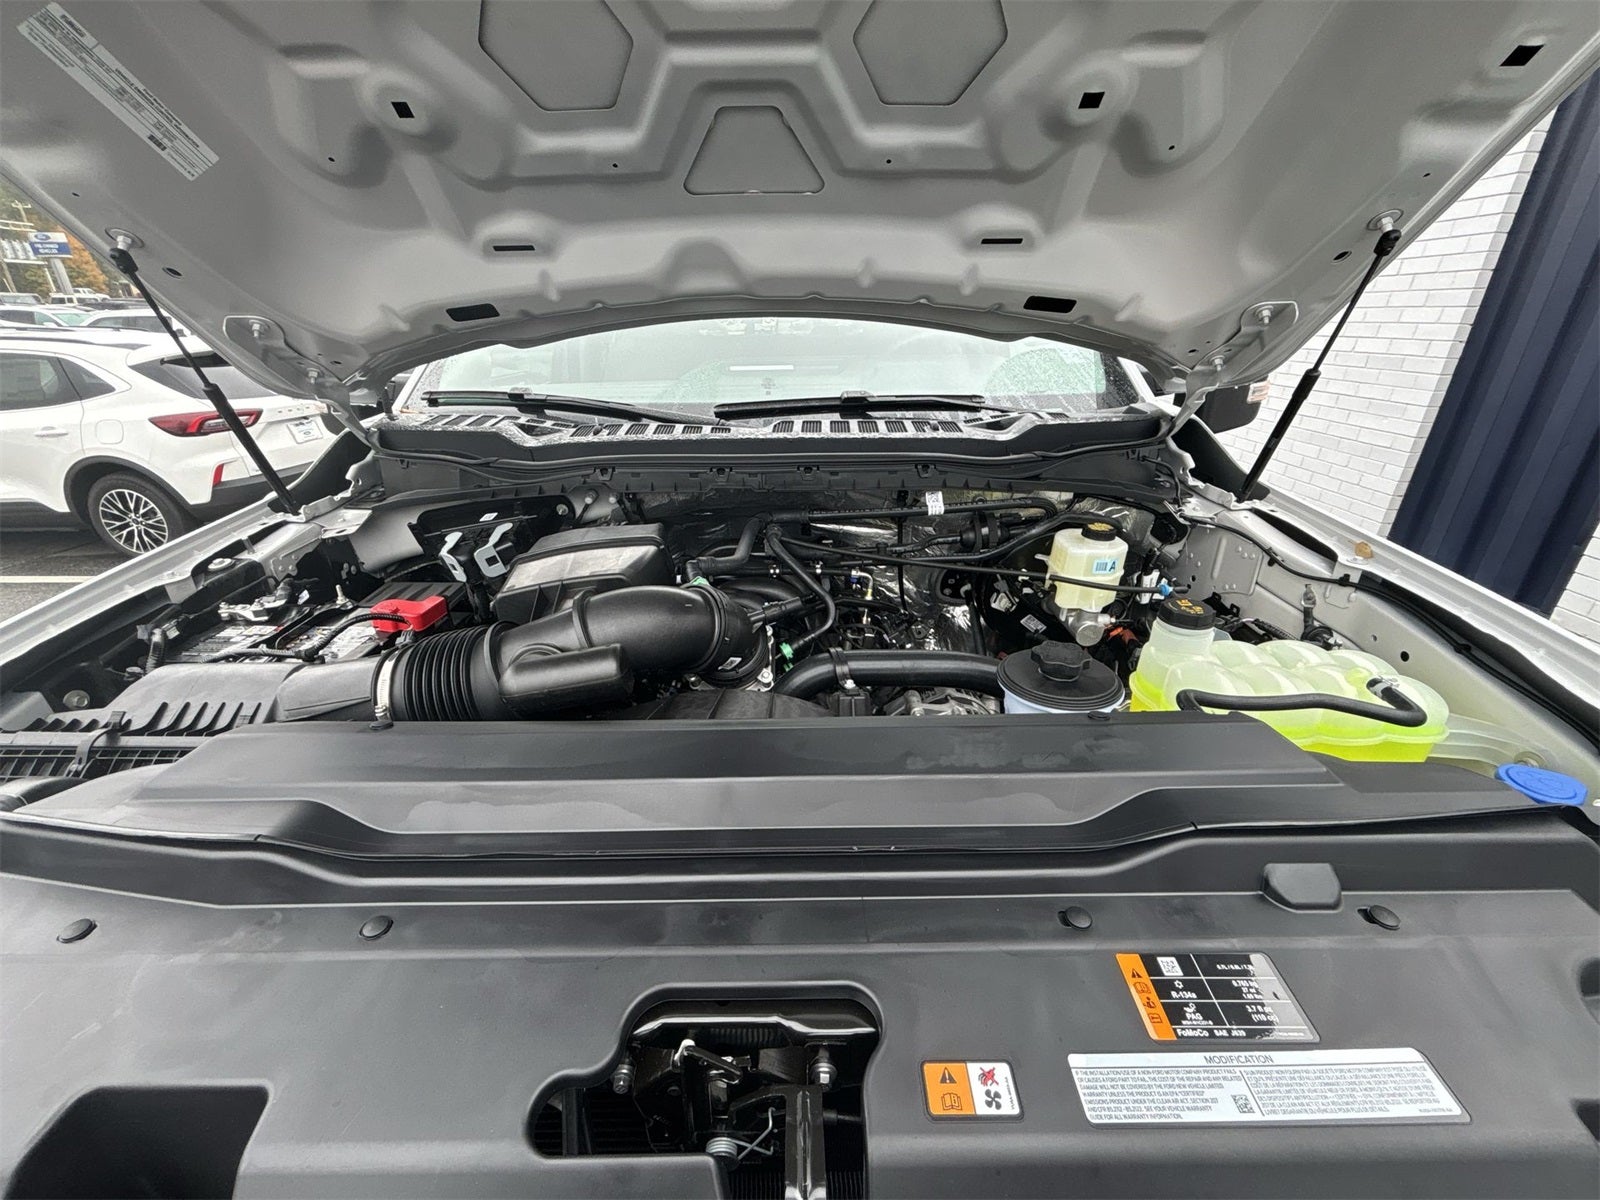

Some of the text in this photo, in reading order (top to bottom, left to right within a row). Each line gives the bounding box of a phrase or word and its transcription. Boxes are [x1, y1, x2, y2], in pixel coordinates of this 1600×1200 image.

[1108, 560, 1116, 572] A
[1171, 991, 1197, 999] R-134a
[1204, 1054, 1274, 1064] MODIFICATION
